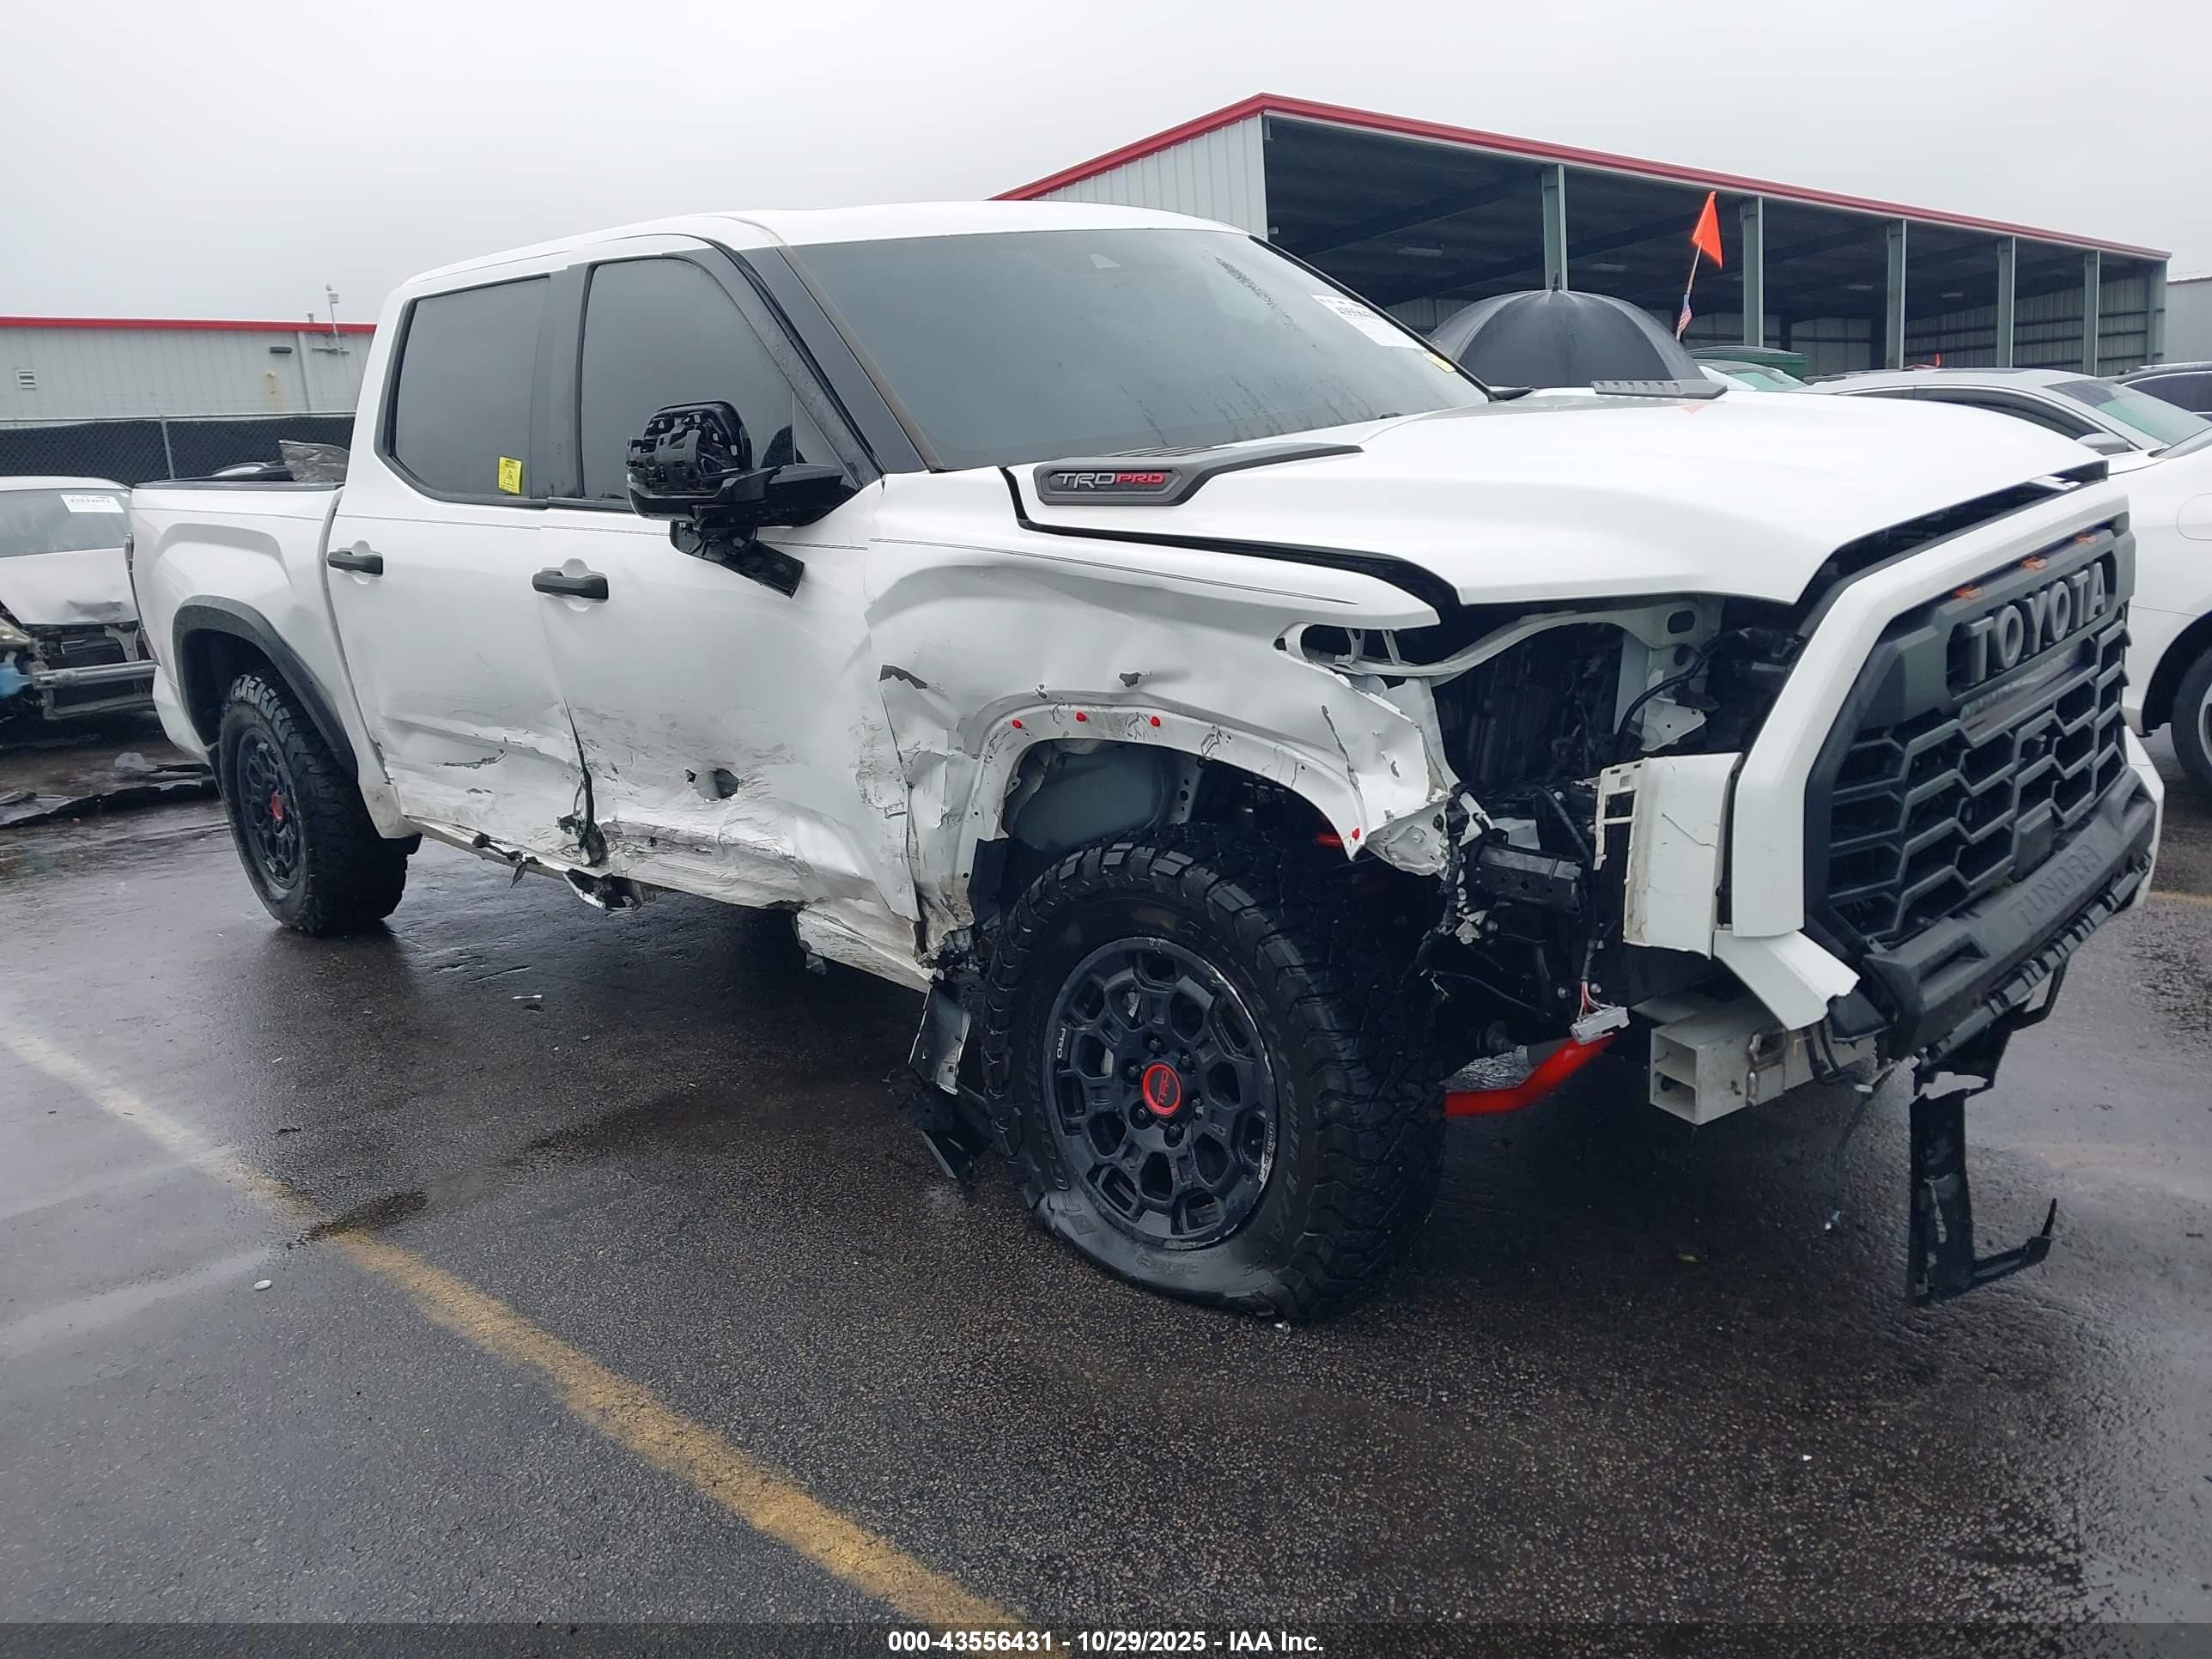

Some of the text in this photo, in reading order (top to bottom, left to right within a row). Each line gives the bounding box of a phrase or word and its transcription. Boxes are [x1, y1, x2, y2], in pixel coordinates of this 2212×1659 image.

[1057, 473, 1166, 489] TRD PRO
[1969, 562, 2106, 684] TOYOTA
[2010, 844, 2104, 927] TUNDRA
[1056, 1027, 1066, 1059] PRO
